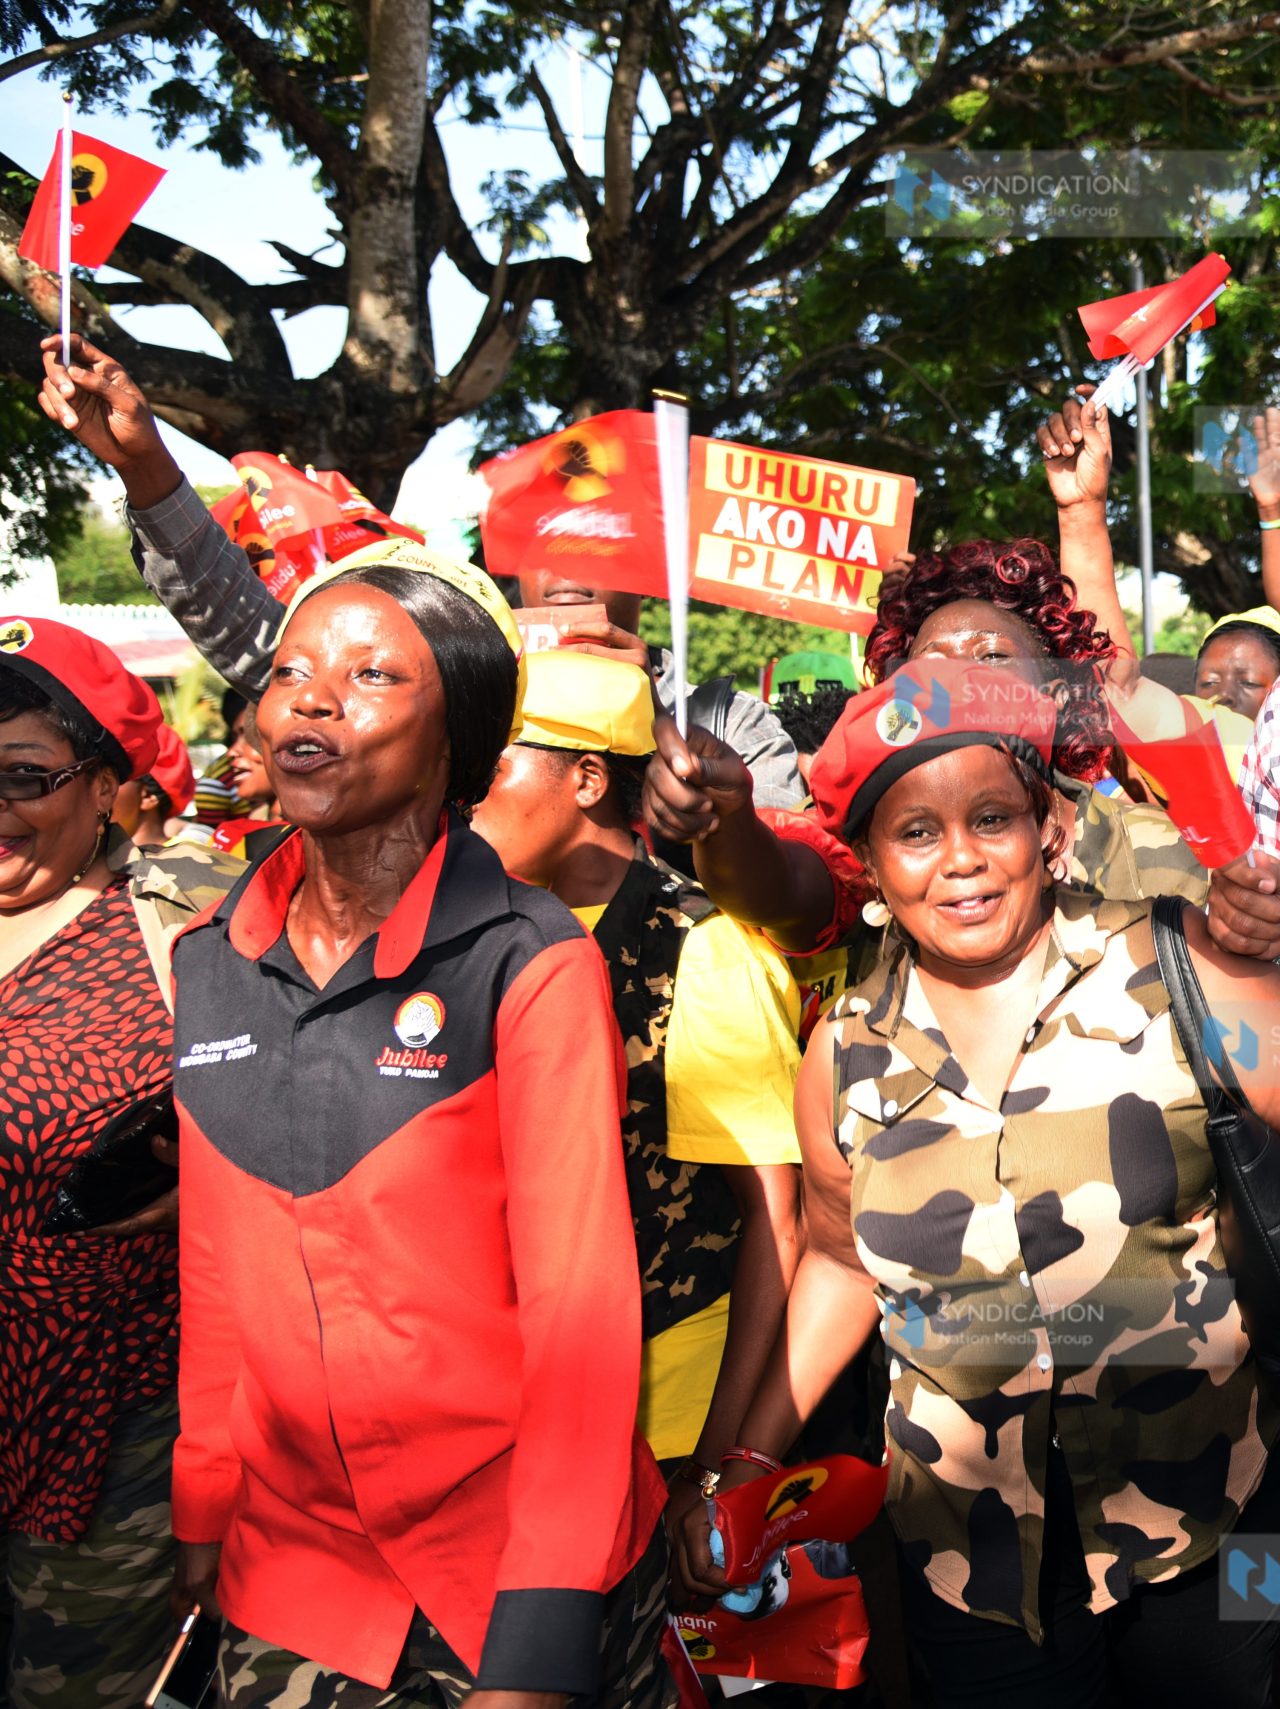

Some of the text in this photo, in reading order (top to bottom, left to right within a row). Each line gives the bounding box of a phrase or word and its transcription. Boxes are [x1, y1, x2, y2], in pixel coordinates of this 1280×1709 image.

[725, 453, 882, 517] UHURU
[712, 497, 879, 566] AKO NA
[727, 544, 865, 606] PLAN
[376, 1046, 449, 1069] Jubilee
[673, 1615, 718, 1633] Jubil
